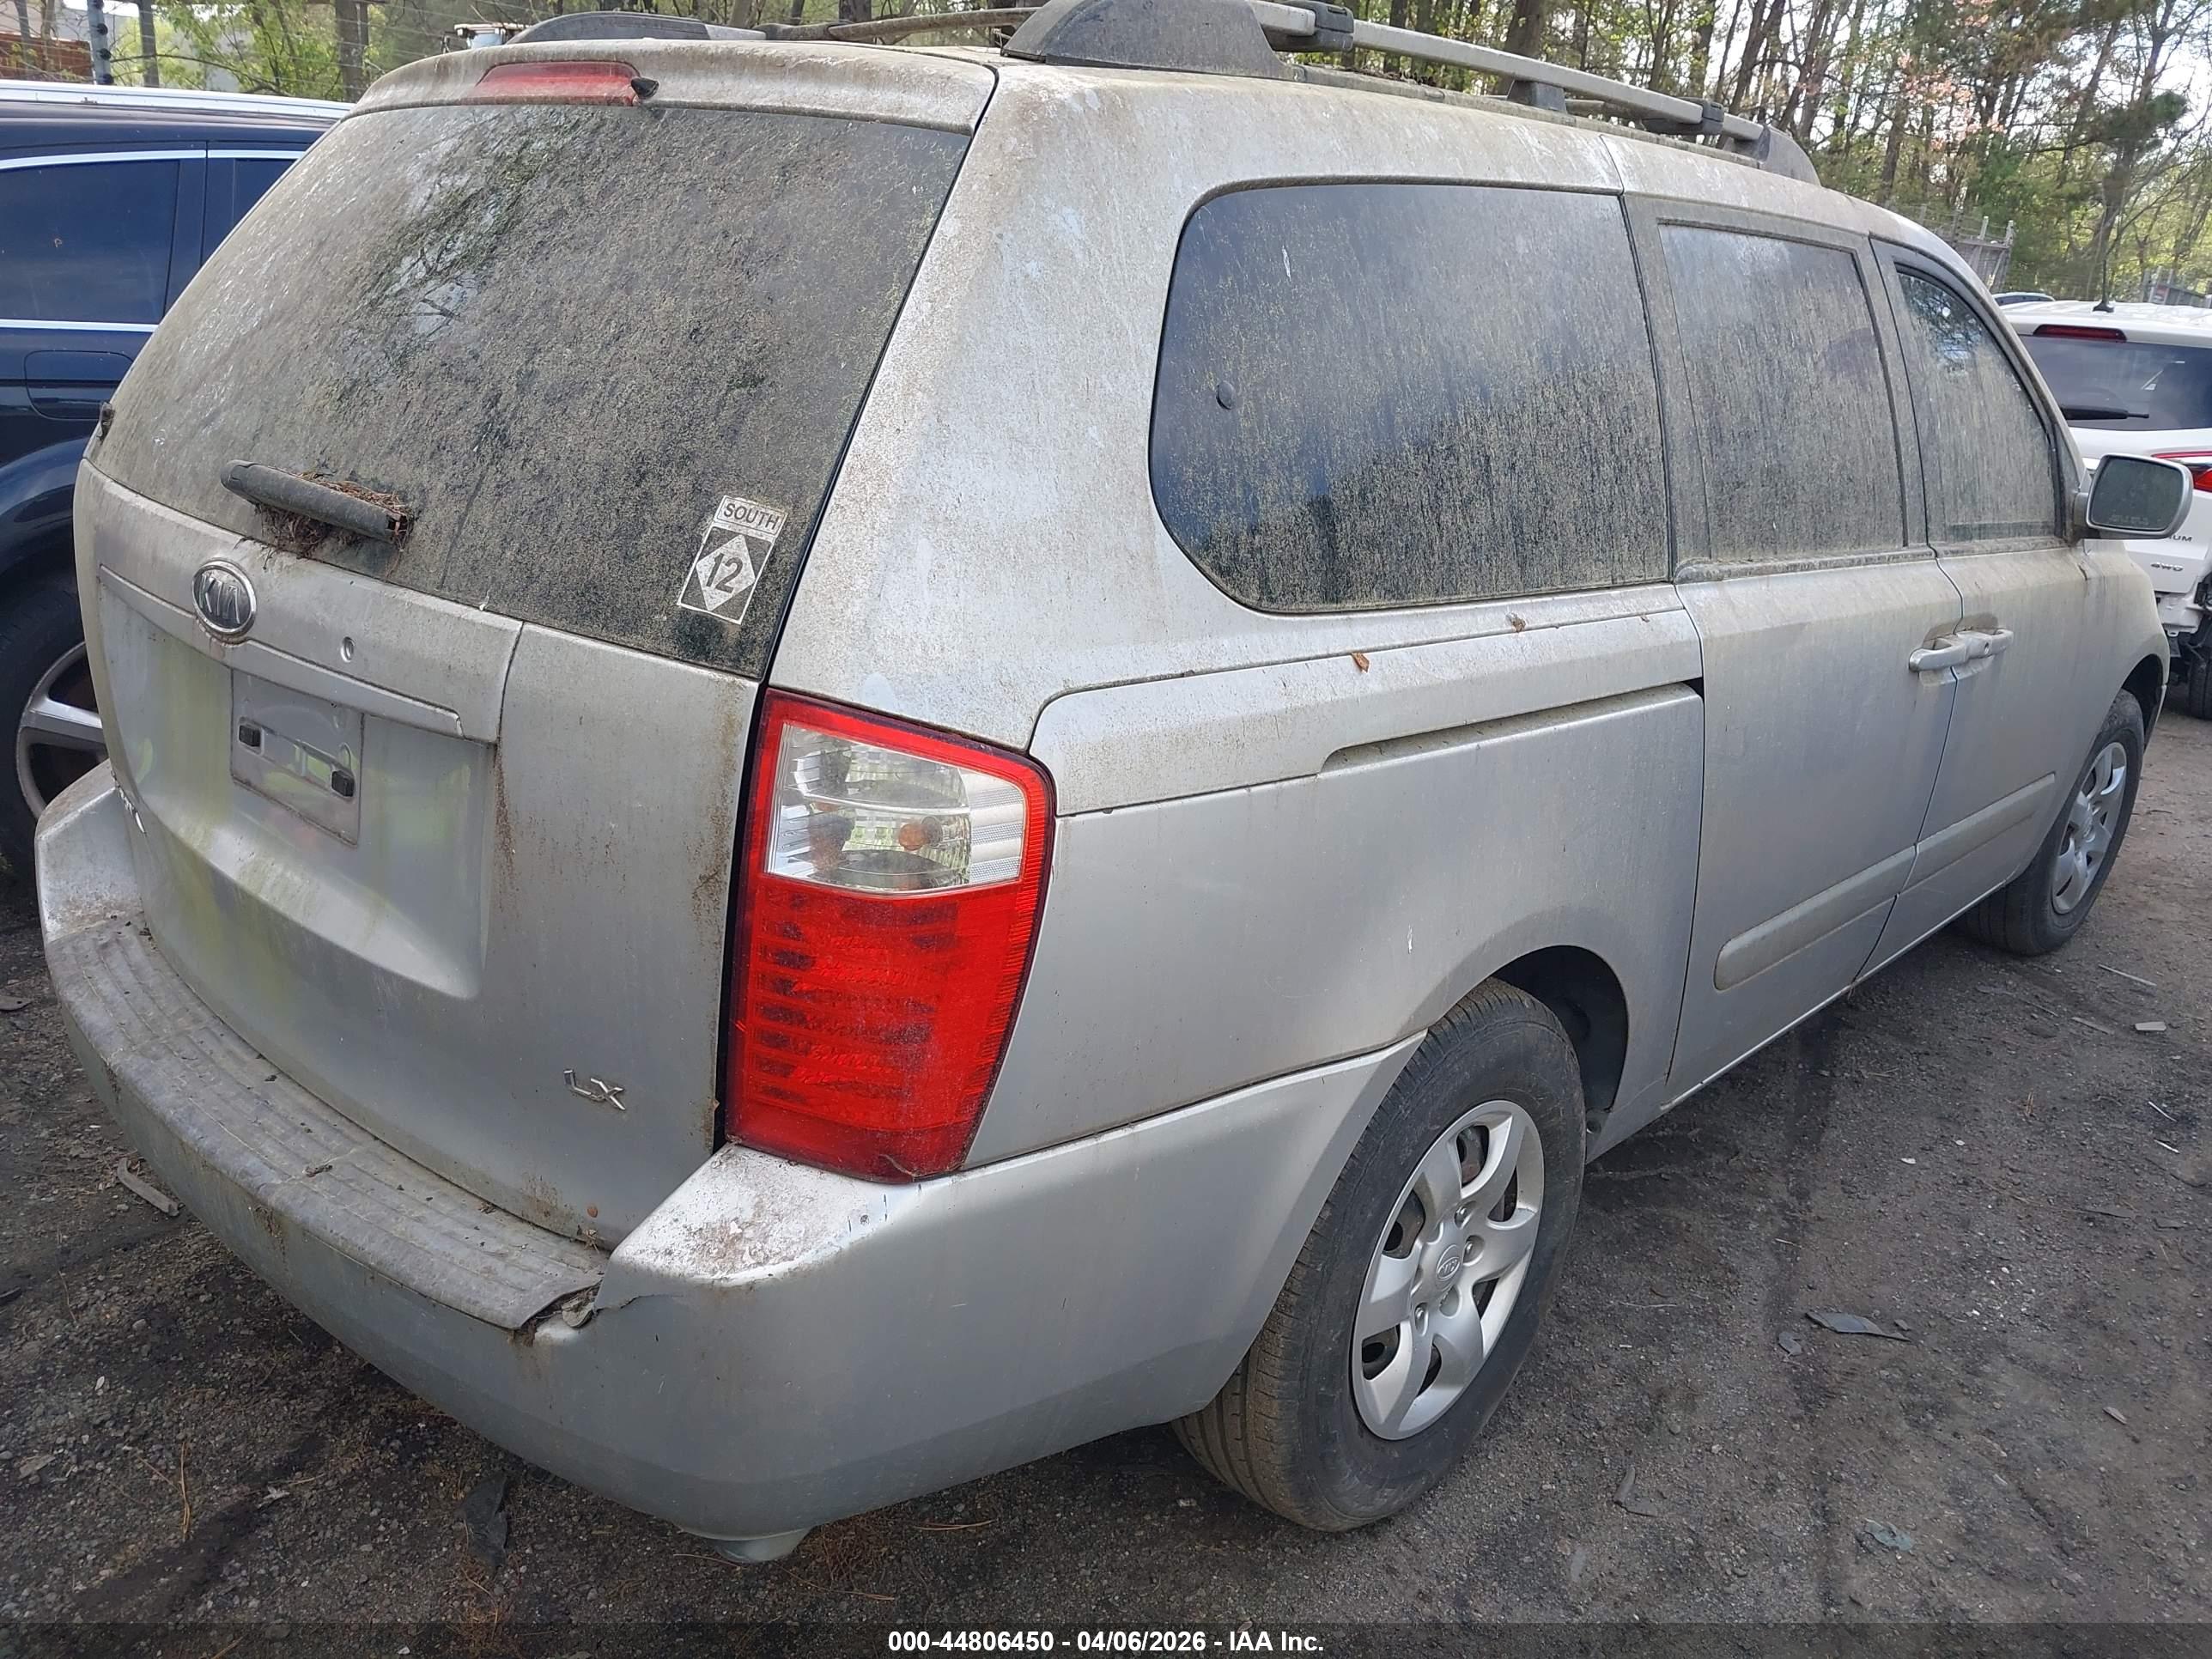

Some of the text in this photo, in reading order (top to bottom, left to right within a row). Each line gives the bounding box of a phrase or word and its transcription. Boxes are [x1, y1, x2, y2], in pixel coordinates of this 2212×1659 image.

[723, 503, 780, 530] SOUTH
[706, 552, 744, 594] 12
[563, 1068, 626, 1111] LX
